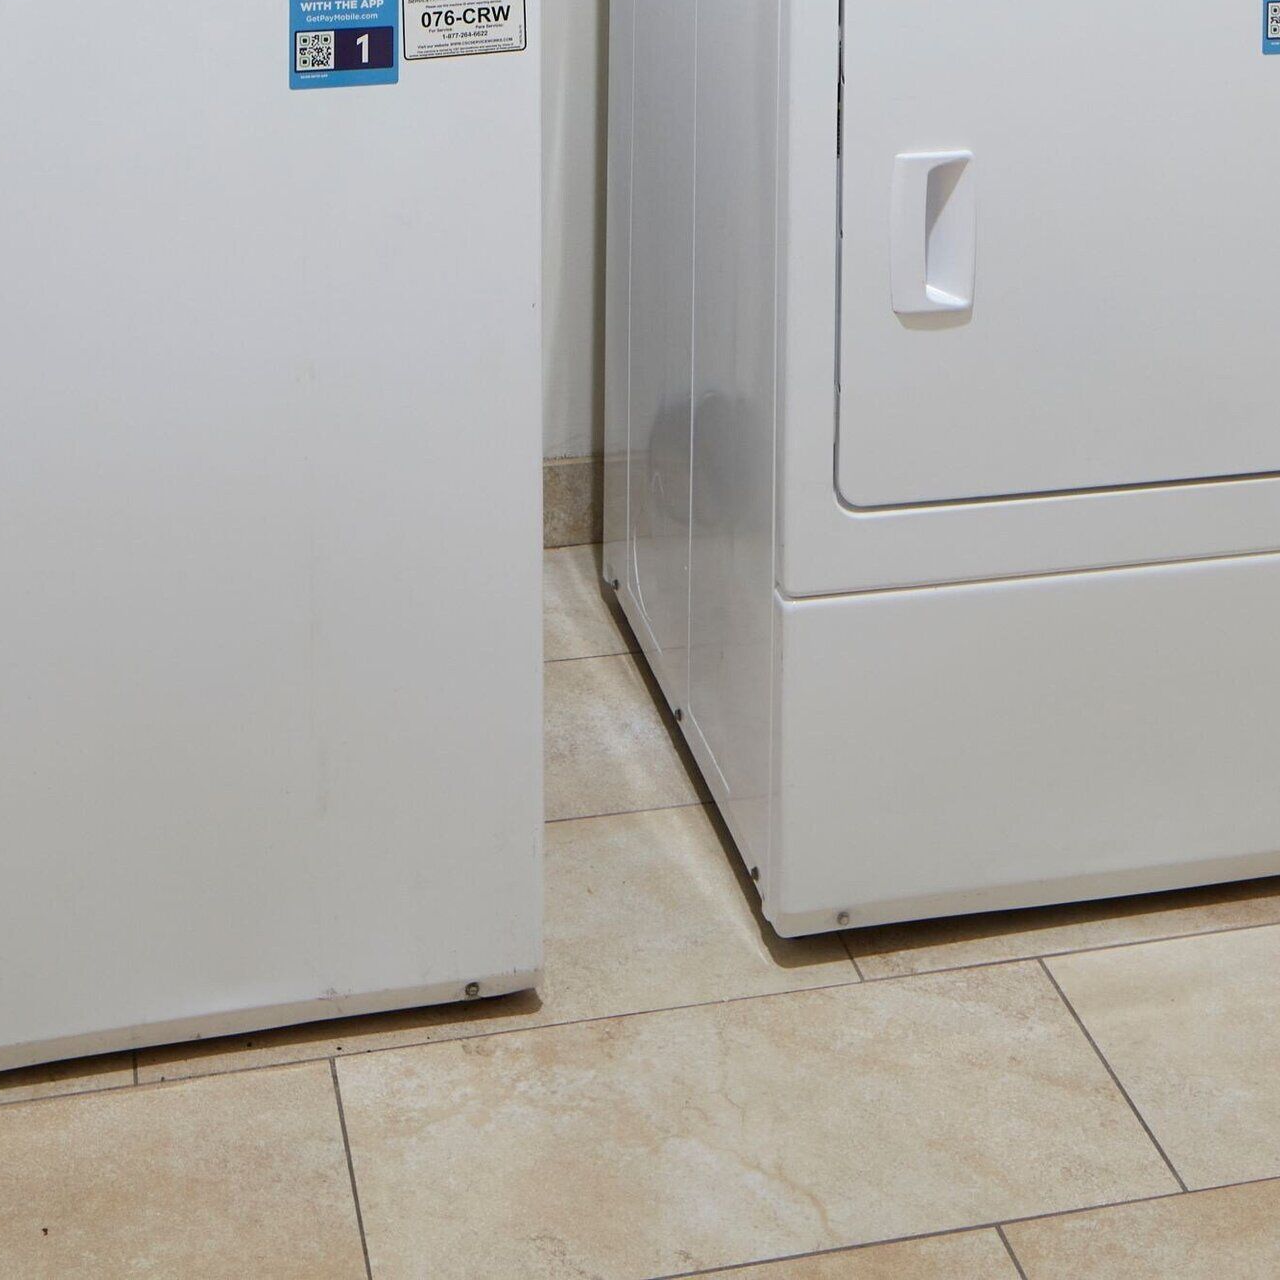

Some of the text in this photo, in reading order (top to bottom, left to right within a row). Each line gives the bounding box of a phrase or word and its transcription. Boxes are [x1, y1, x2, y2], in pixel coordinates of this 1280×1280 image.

[300, 0, 384, 12] WITH THE APP
[306, 13, 378, 23] GetPayMobile.com
[421, 5, 511, 28] 076-CRW
[356, 33, 369, 63] 1
